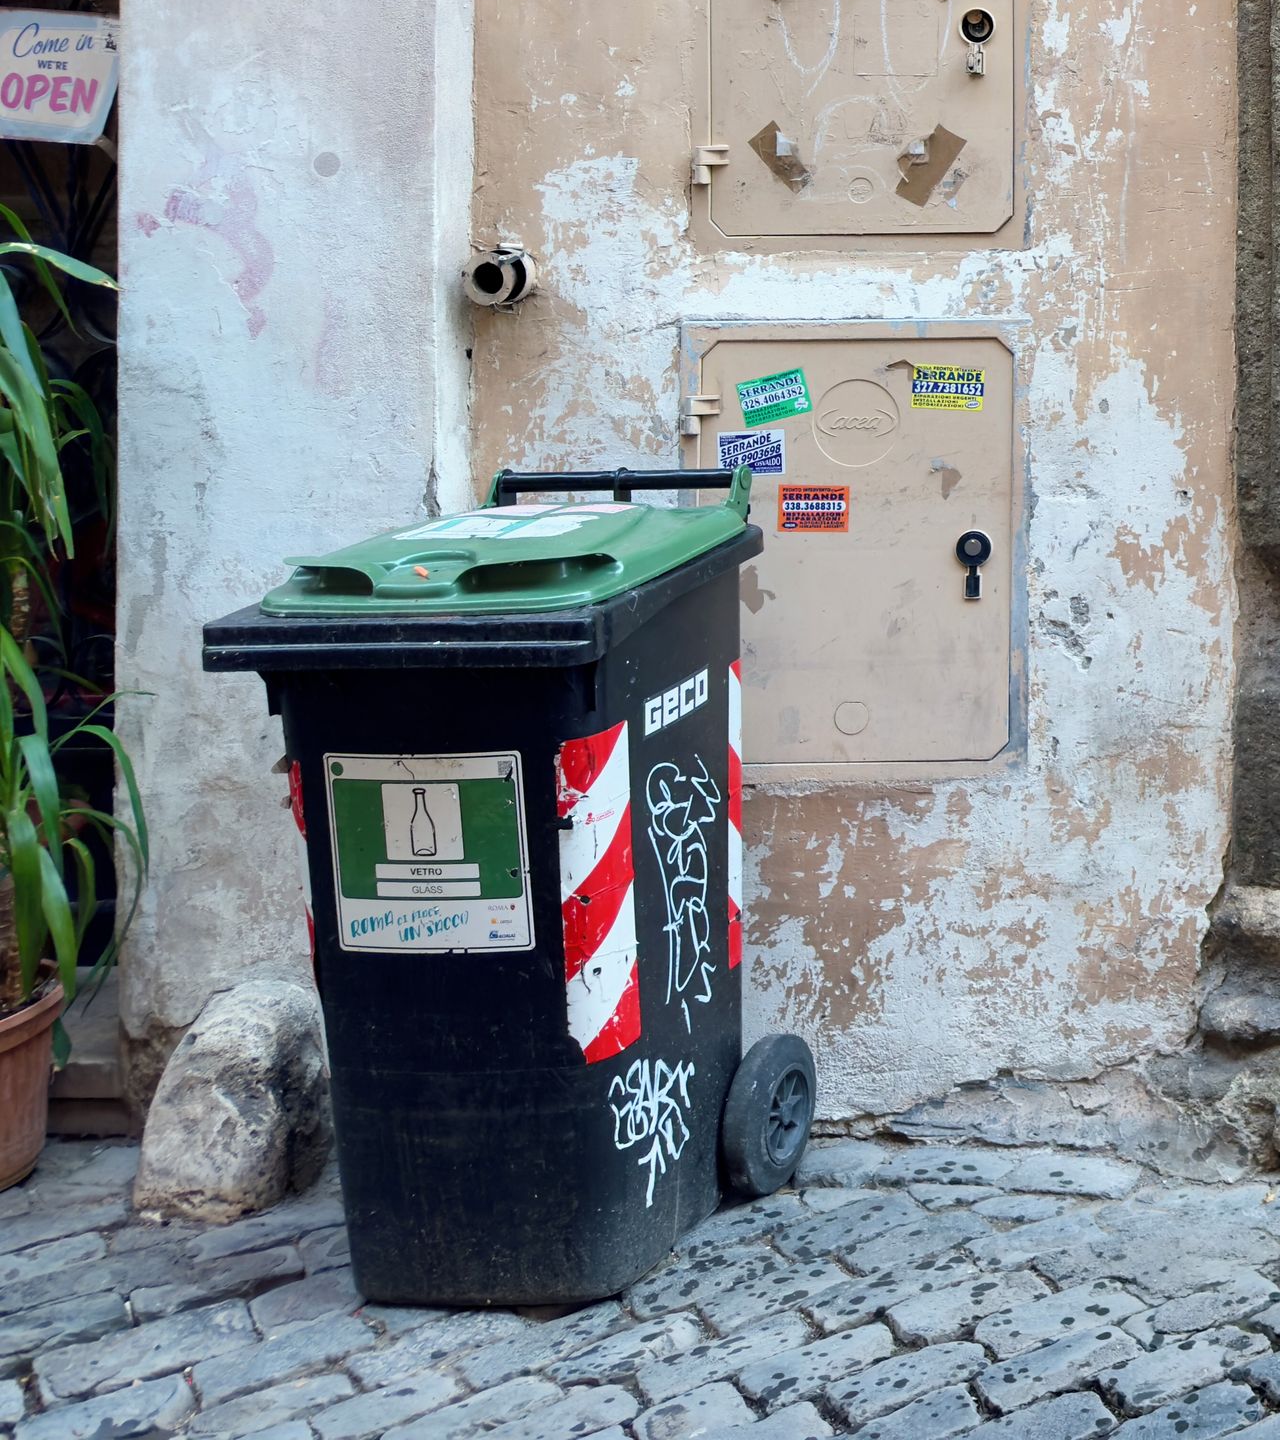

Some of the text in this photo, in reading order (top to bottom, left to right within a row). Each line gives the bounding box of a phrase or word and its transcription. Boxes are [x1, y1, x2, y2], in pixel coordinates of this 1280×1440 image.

[13, 22, 70, 58] Come
[75, 34, 94, 52] in
[0, 72, 99, 115] OPEN
[916, 369, 982, 383] SERRANDE
[740, 375, 801, 398] SERRANDE
[914, 381, 982, 396] 327.7381652
[743, 385, 803, 410] 328.4064382
[830, 416, 882, 430] acea
[721, 432, 772, 458] SERRANDE
[783, 493, 845, 501] SERRANDE
[784, 502, 842, 510] 338.3688315
[410, 867, 443, 876] VETRO
[411, 885, 443, 894] GLASS
[350, 910, 394, 938] ROMA
[398, 924, 421, 943] UN
